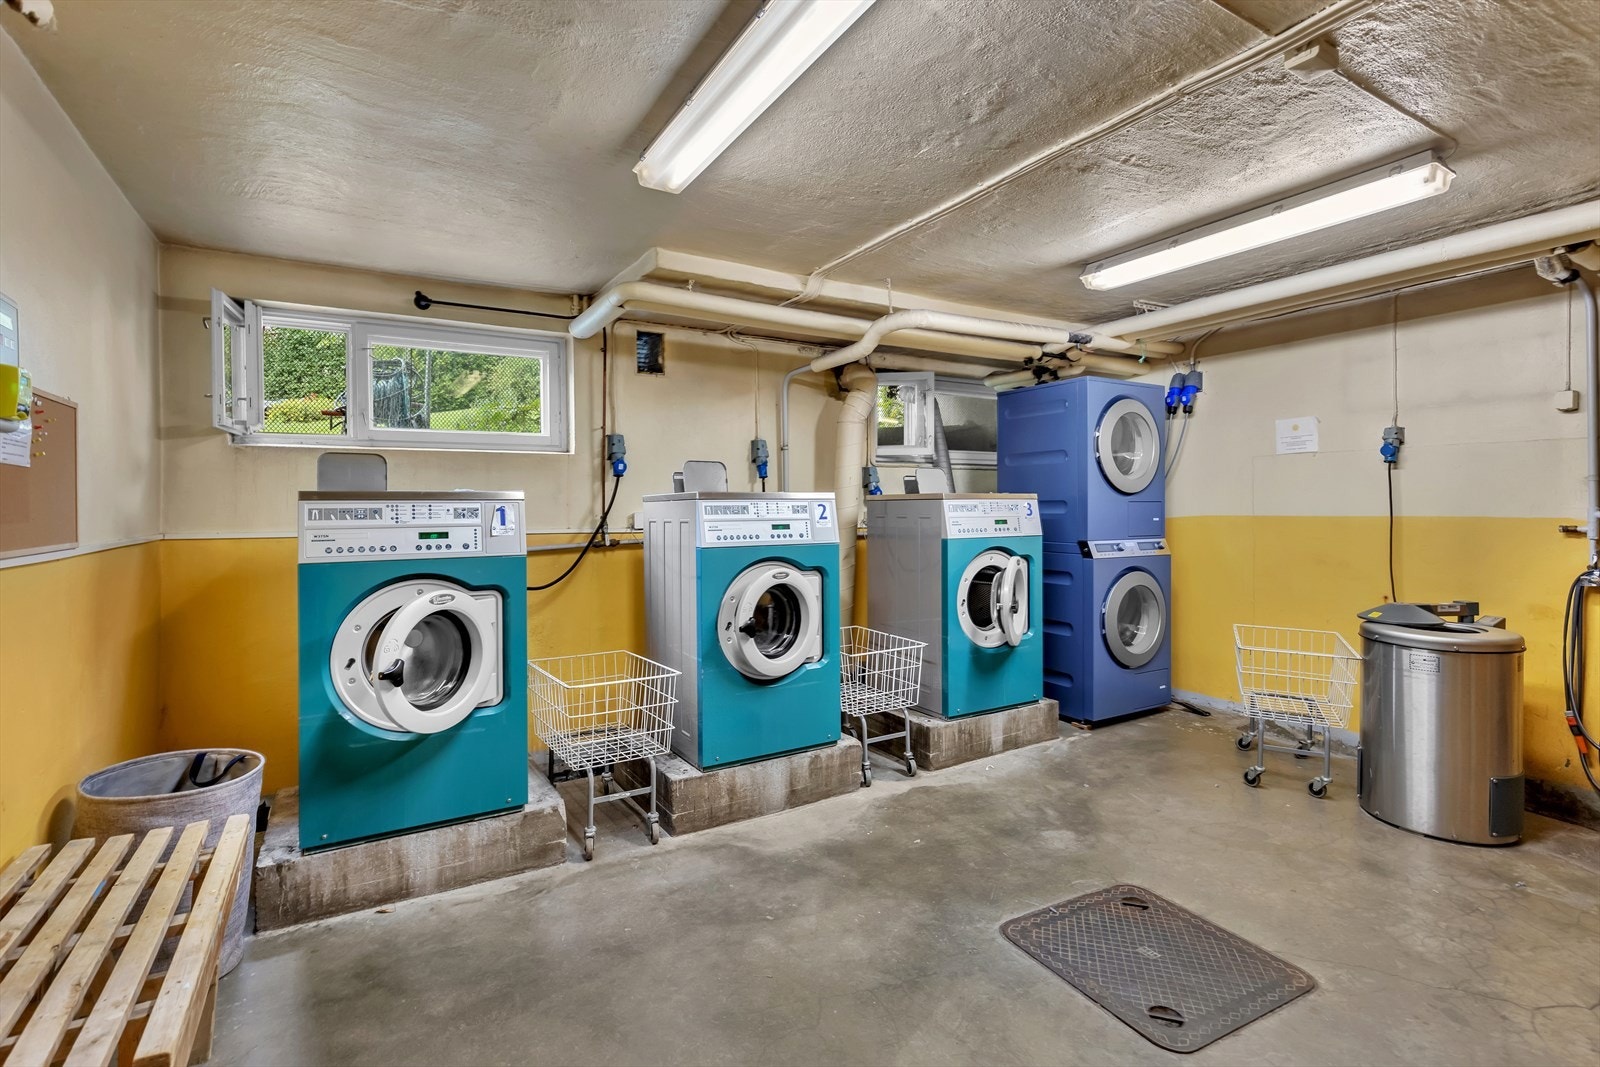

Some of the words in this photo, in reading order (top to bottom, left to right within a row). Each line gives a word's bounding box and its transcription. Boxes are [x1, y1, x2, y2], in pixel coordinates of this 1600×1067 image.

[495, 505, 506, 526] 1
[817, 503, 828, 520] 2
[1026, 502, 1033, 516] 3
